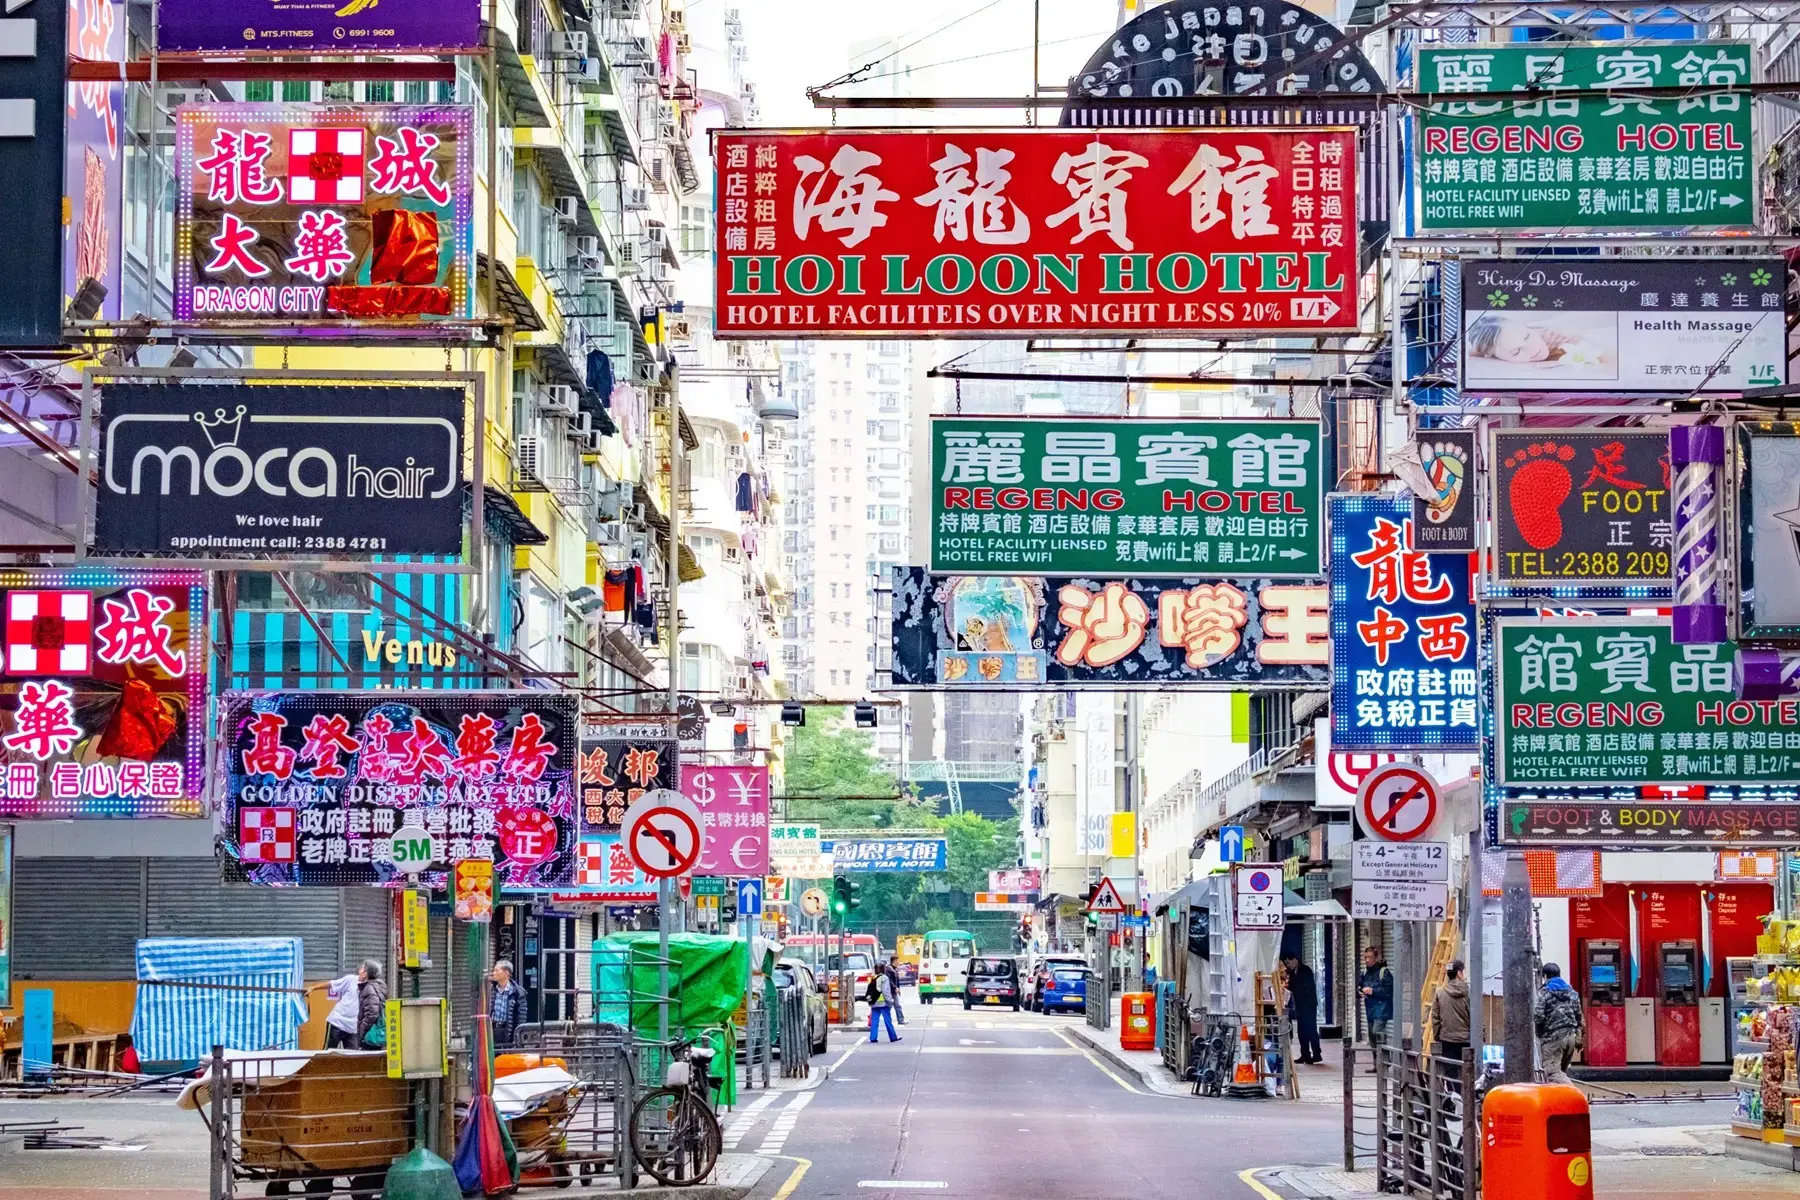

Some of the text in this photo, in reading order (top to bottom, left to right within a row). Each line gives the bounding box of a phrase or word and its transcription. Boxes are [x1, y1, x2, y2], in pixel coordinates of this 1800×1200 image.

[260, 30, 314, 38] MTS.FITNESS
[349, 29, 395, 37] 6991 9608
[1163, 6, 1264, 40] japan
[1425, 122, 1745, 154] REGENG HOTEL
[195, 126, 452, 207] 龍 城
[1425, 155, 1745, 184] 持牌賓館 酒店設備 豪華套房 歡迎自由行
[725, 143, 749, 251] 酒店設備
[753, 143, 778, 251] 純粹租房
[792, 141, 1280, 252] 海龍賓館
[1291, 141, 1315, 247] 全日特平
[1318, 140, 1344, 248] 時租過夜
[1426, 188, 1571, 204] HOTEL FACILITY LIENSED
[1666, 186, 1719, 214] 請上2/F
[1426, 205, 1524, 219] HOTEL FREE WIFI
[726, 251, 1345, 296] HOI LOON HOTEL
[1528, 269, 1558, 288] Da
[1561, 269, 1640, 293] Massage
[193, 285, 325, 312] DRAGON CITY
[1639, 291, 1780, 308] 慶達養生館
[727, 301, 1334, 325] HOTEL FACILITEIS OVER NIGHT LESS 20% 1/F
[1633, 319, 1753, 334] Health Massage
[1749, 363, 1776, 378] 1/F
[940, 430, 1311, 489] 麗晶賓館
[131, 445, 435, 499] moca hair
[943, 487, 1306, 514] REGENG HOTEL
[1581, 490, 1665, 514] FOOT
[235, 513, 323, 527] We love hair
[939, 512, 1309, 538] 持牌賓館 酒店設備 豪華套房 歡迎自由行
[170, 534, 387, 550] appointment call: 2388 4781
[939, 538, 1108, 551] HOTEL FACILITY LIENSED
[1421, 527, 1469, 541] FOOT & BODY
[939, 551, 1053, 563] HOTEL FREE WIFI
[1218, 541, 1277, 565] 請上2/F
[1506, 552, 1620, 577] TEL:2388
[95, 588, 186, 678] 城
[1356, 606, 1471, 667] 中西
[361, 630, 457, 668] Venus
[1356, 667, 1477, 698] 政府註冊
[1356, 698, 1477, 728] 免稅正貨
[1511, 700, 1800, 728] REGENG HOTE
[1512, 733, 1582, 753] 持牌賓館
[1585, 732, 1655, 752] 酒店設備
[1660, 732, 1729, 751] 豪華套房
[1513, 755, 1649, 766] HOTEL FACILITY LIENSED
[1513, 766, 1648, 778] HOTEL FREE WIFI
[1743, 754, 1790, 776] 請上2/F
[50, 761, 184, 799] 信心保證
[240, 785, 498, 804] GOLDEN DISPENSARY
[301, 807, 396, 836] 政府註冊
[1532, 809, 1798, 826] FOOT & BODY MASSAGE
[392, 838, 432, 862] 5M
[1425, 846, 1442, 859] 12
[901, 860, 936, 868] HOTEL
[1361, 861, 1384, 869] Except
[1266, 896, 1273, 907] 7
[1399, 902, 1426, 910] midnight
[1428, 905, 1444, 918] 12
[1267, 914, 1280, 924] 12
